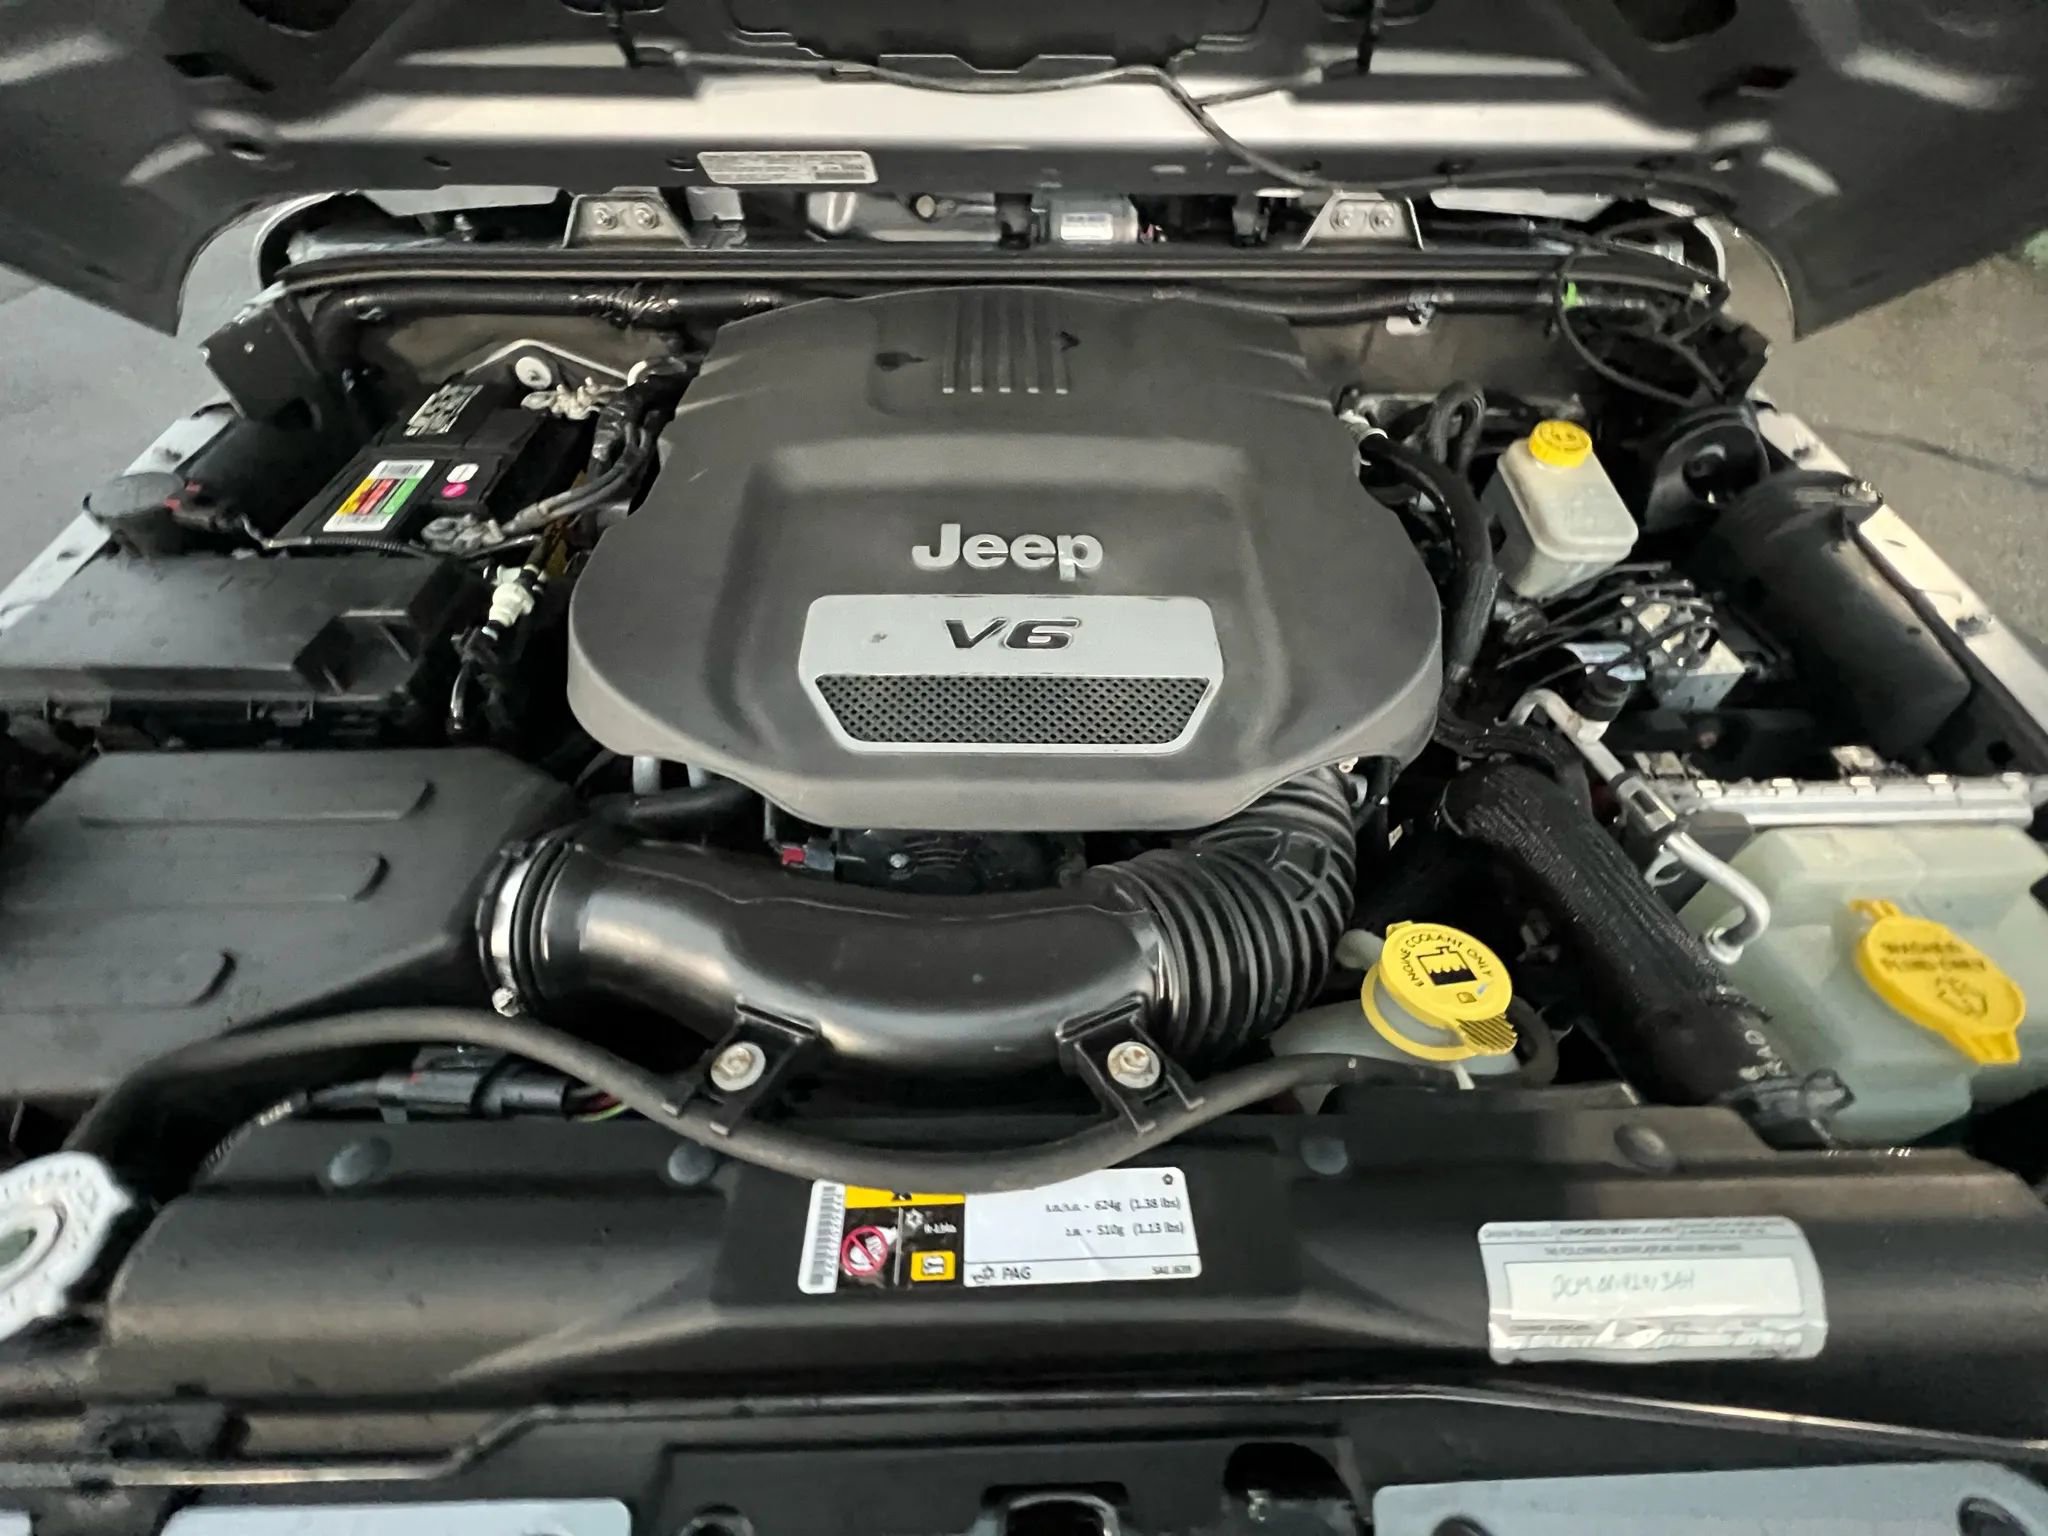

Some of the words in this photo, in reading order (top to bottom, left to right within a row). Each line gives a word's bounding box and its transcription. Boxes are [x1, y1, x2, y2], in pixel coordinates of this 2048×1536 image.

[912, 523, 1103, 581] Jeep
[944, 618, 1081, 650] V6
[1405, 933, 1463, 948] COOLANT
[1400, 947, 1424, 987] ENGINE
[1466, 947, 1493, 977] ONLY
[1002, 1266, 1032, 1280] PAG
